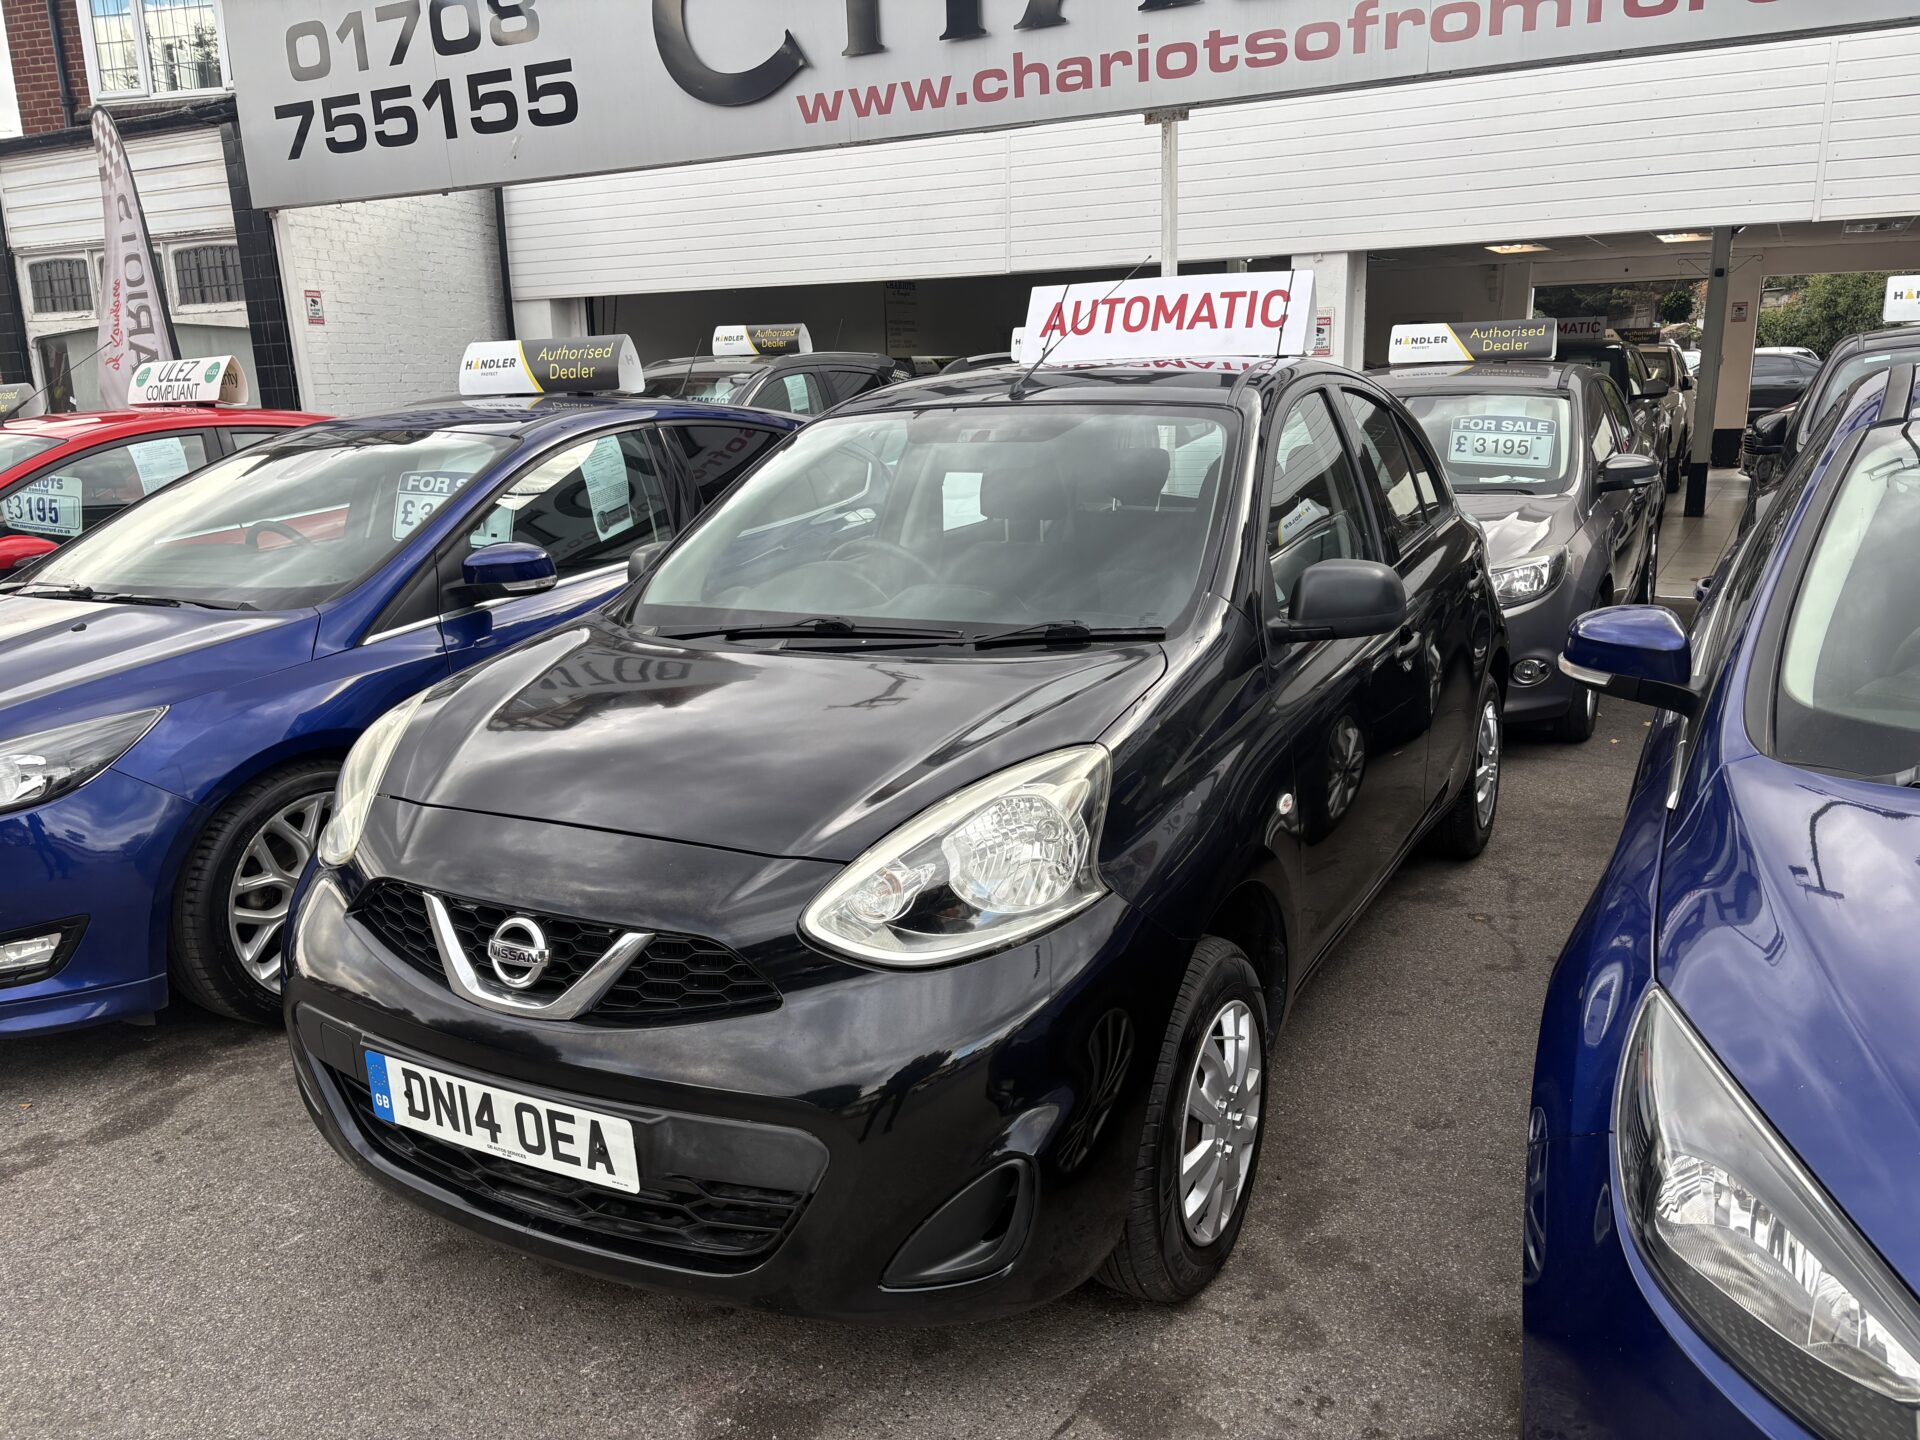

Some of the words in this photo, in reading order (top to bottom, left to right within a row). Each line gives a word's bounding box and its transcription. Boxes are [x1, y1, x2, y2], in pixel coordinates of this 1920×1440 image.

[285, 0, 540, 82] 01708
[274, 58, 579, 161] 755155
[1039, 289, 1292, 338] AUTOMATIC
[755, 328, 796, 338] Authorised
[1471, 325, 1546, 339] Authorised
[1557, 322, 1600, 335] MATIC
[537, 342, 614, 361] Authorised
[762, 339, 787, 347] Dealer
[1483, 340, 1529, 352] Dealer
[158, 361, 200, 382] ULEZ
[550, 363, 596, 380] Dealer
[146, 383, 200, 401] COMPLIANT
[1460, 419, 1497, 431] FOR
[1501, 421, 1550, 433] SALE
[1455, 435, 1468, 452] £
[1474, 437, 1530, 456] 3195
[406, 475, 451, 493] FOR
[490, 944, 539, 963] NISSAN
[375, 1093, 390, 1109] GB
[400, 1066, 503, 1144] DN14
[514, 1101, 617, 1176] OEA
